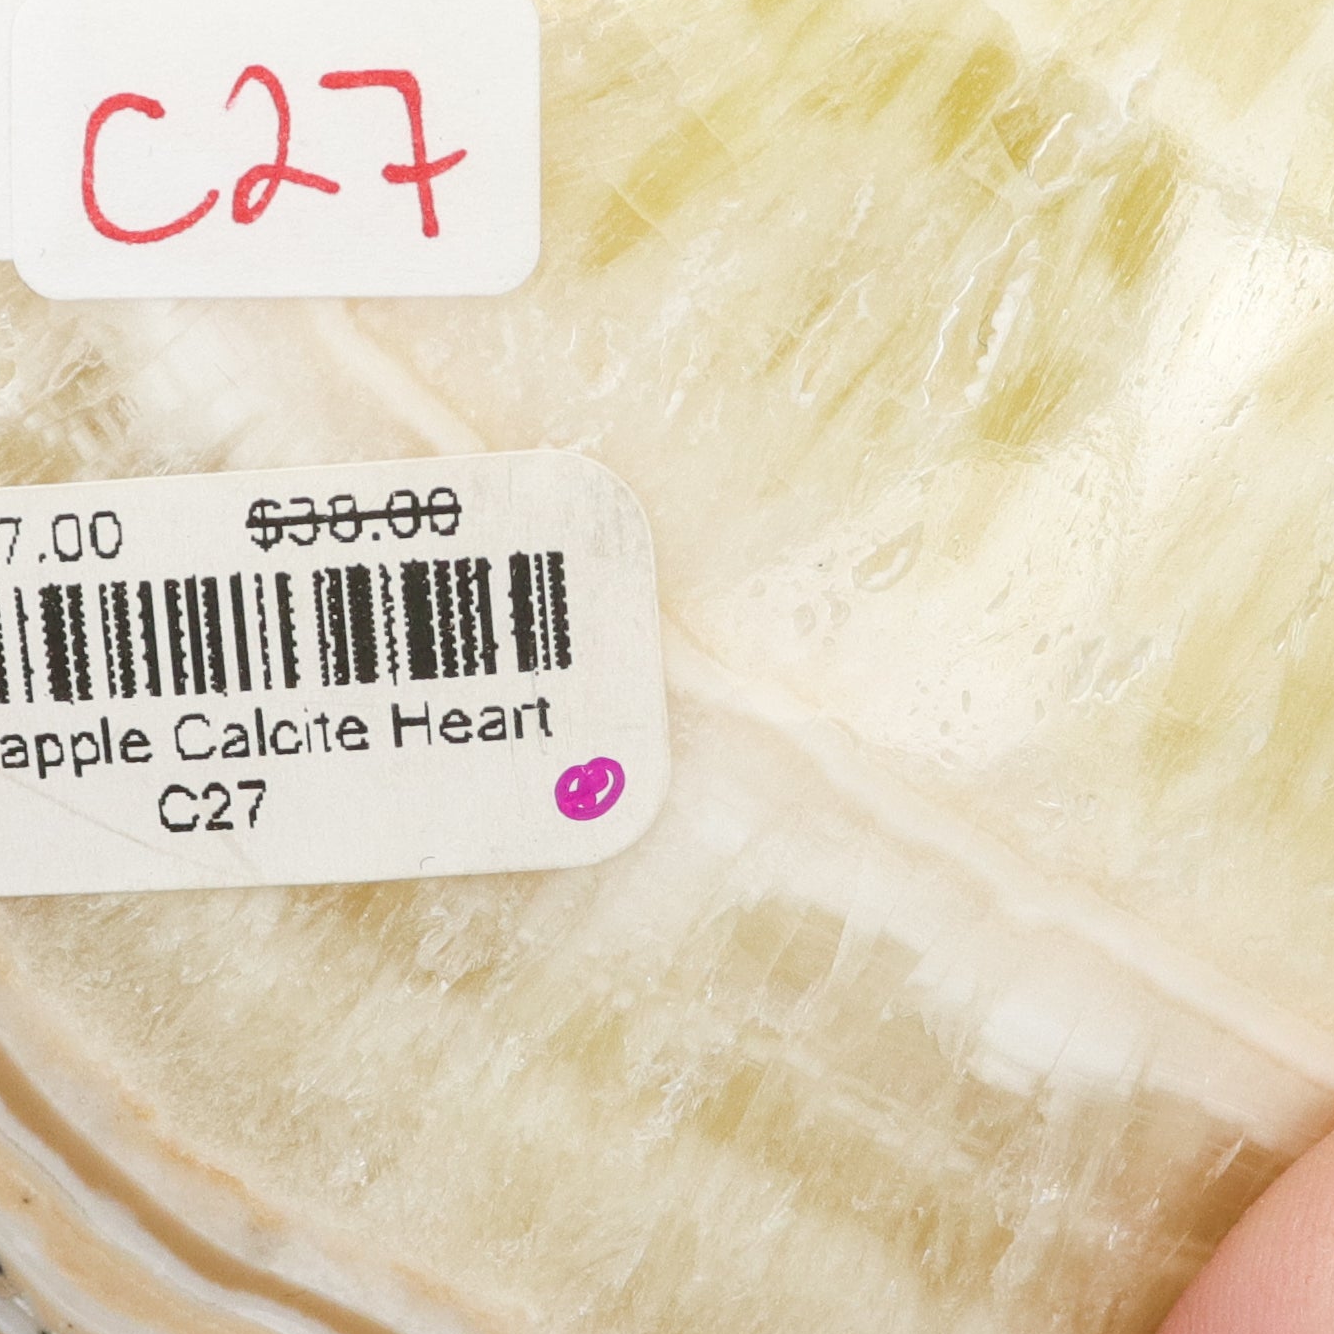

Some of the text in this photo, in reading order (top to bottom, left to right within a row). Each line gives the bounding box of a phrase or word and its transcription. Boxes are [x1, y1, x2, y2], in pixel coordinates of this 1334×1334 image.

[80, 64, 468, 246] C27
[244, 485, 464, 554] $38.00
[172, 705, 371, 763] Calcite
[390, 695, 554, 749] Heart
[156, 777, 268, 834] C27
